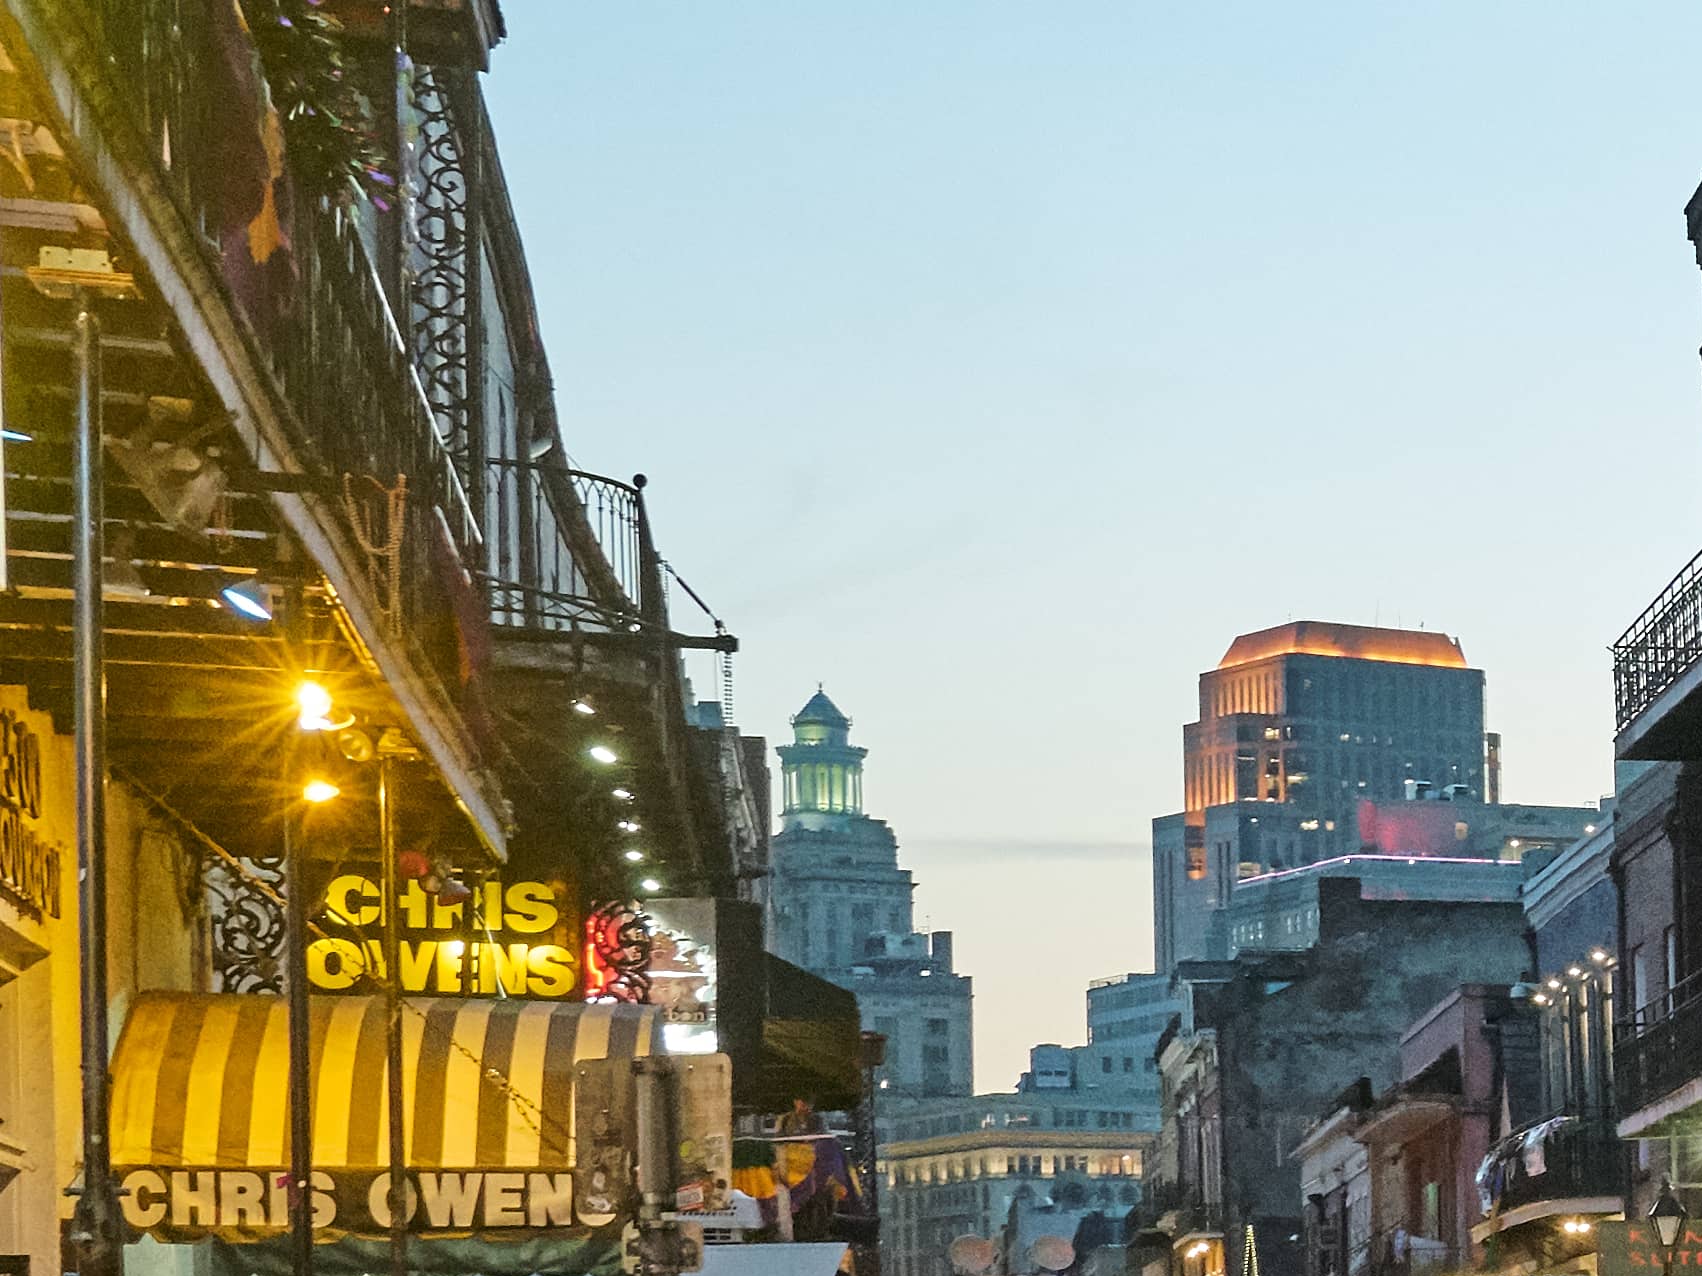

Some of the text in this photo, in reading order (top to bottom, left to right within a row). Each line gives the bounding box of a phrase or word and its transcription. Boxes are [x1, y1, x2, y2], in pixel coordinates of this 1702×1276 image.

[307, 938, 575, 996] OWENS
[119, 1170, 616, 1228] CHRIS OWEN
